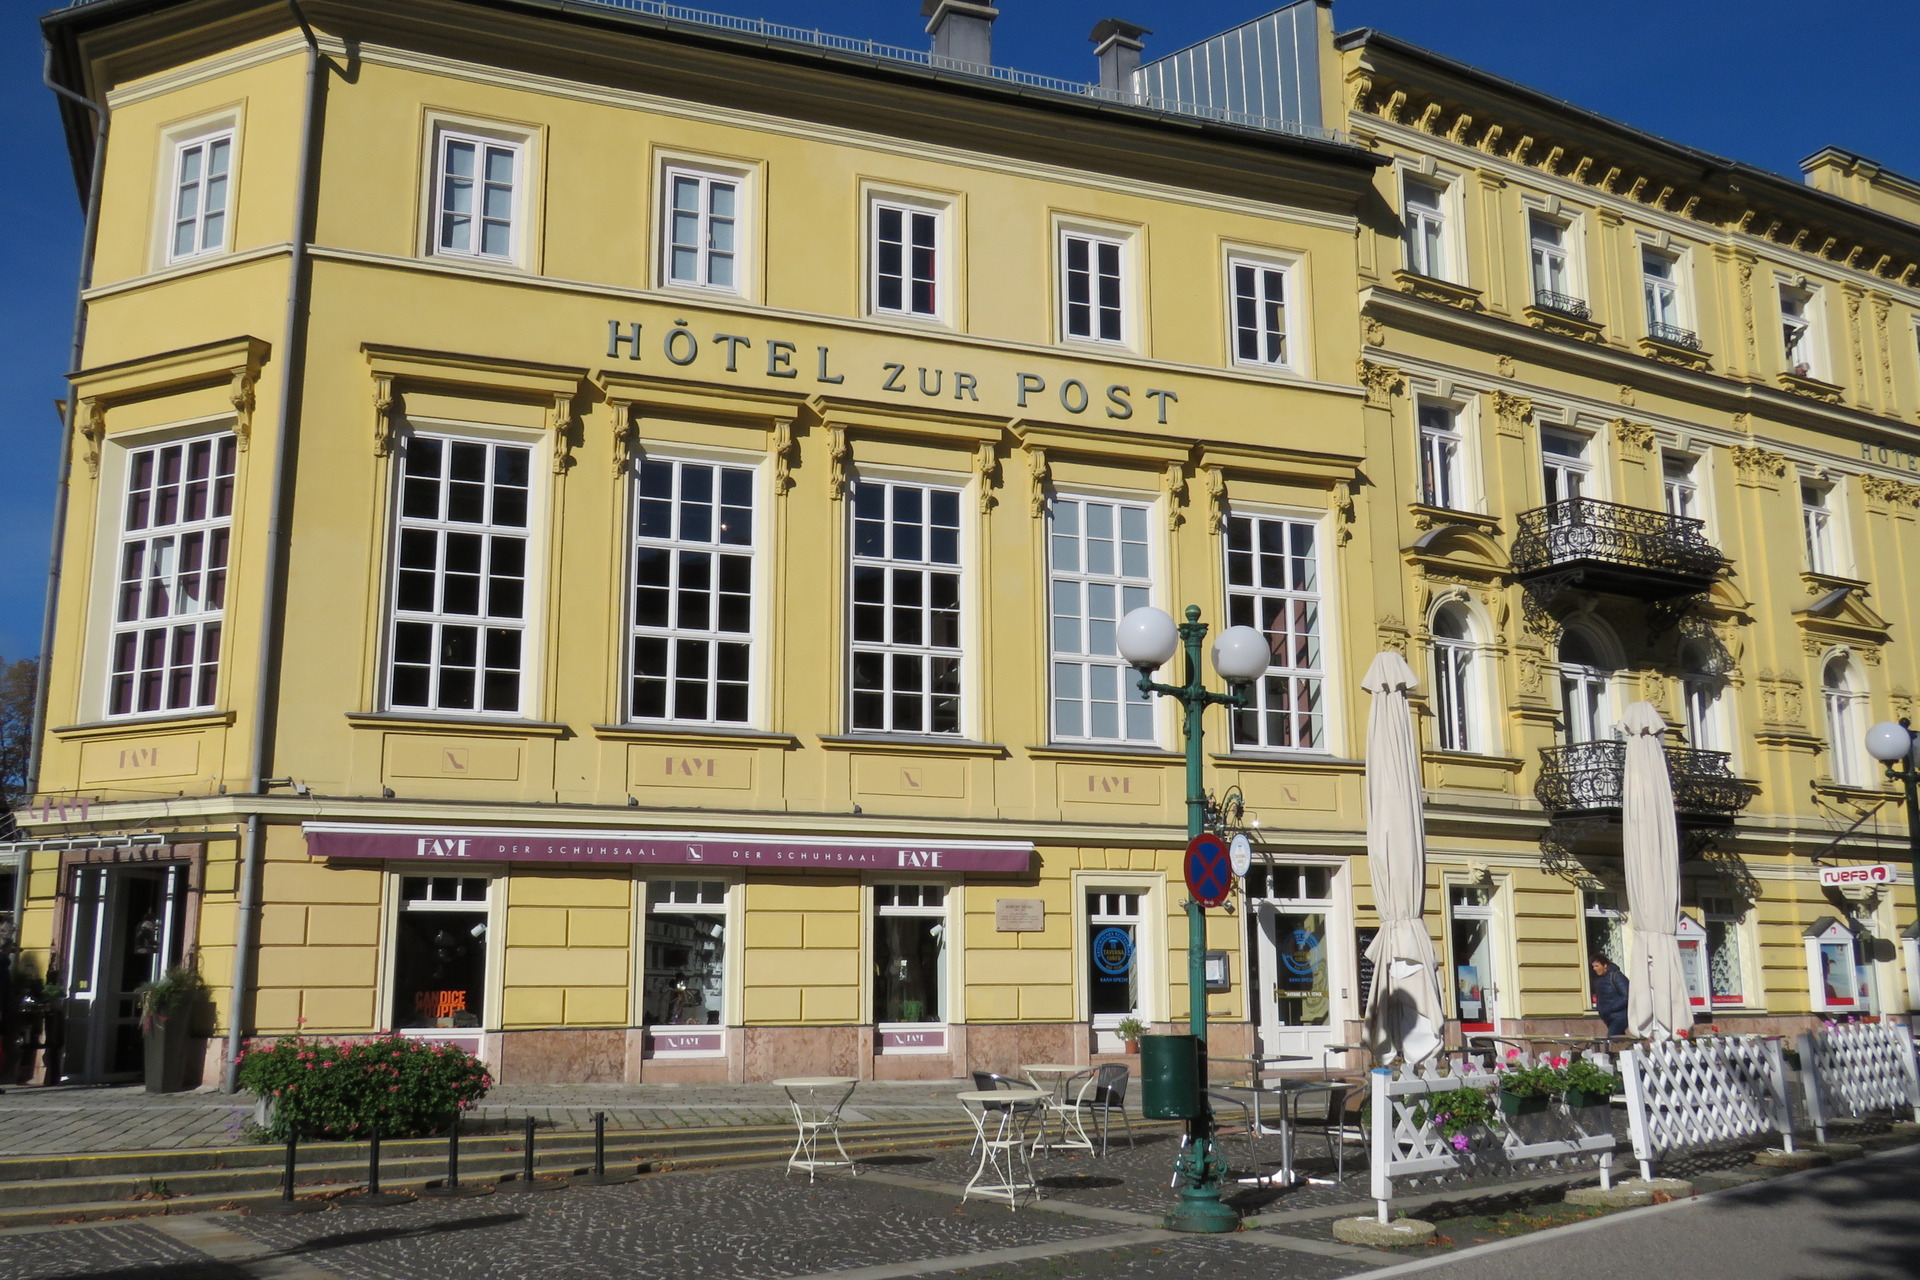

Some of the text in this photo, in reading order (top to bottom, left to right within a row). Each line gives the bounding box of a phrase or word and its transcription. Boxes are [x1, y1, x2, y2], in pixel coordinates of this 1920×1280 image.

[606, 318, 1178, 425] HÔTEL ZUR POST
[119, 747, 160, 769] FAYE
[665, 756, 719, 777] FAYE
[1088, 775, 1134, 794] FAYE
[416, 838, 656, 858] FAYE DER SCHUHSAAL
[732, 850, 943, 868] DER SCHUHSAAL FAYE
[1824, 870, 1868, 883] ruefa
[415, 990, 467, 1004] CANDICE
